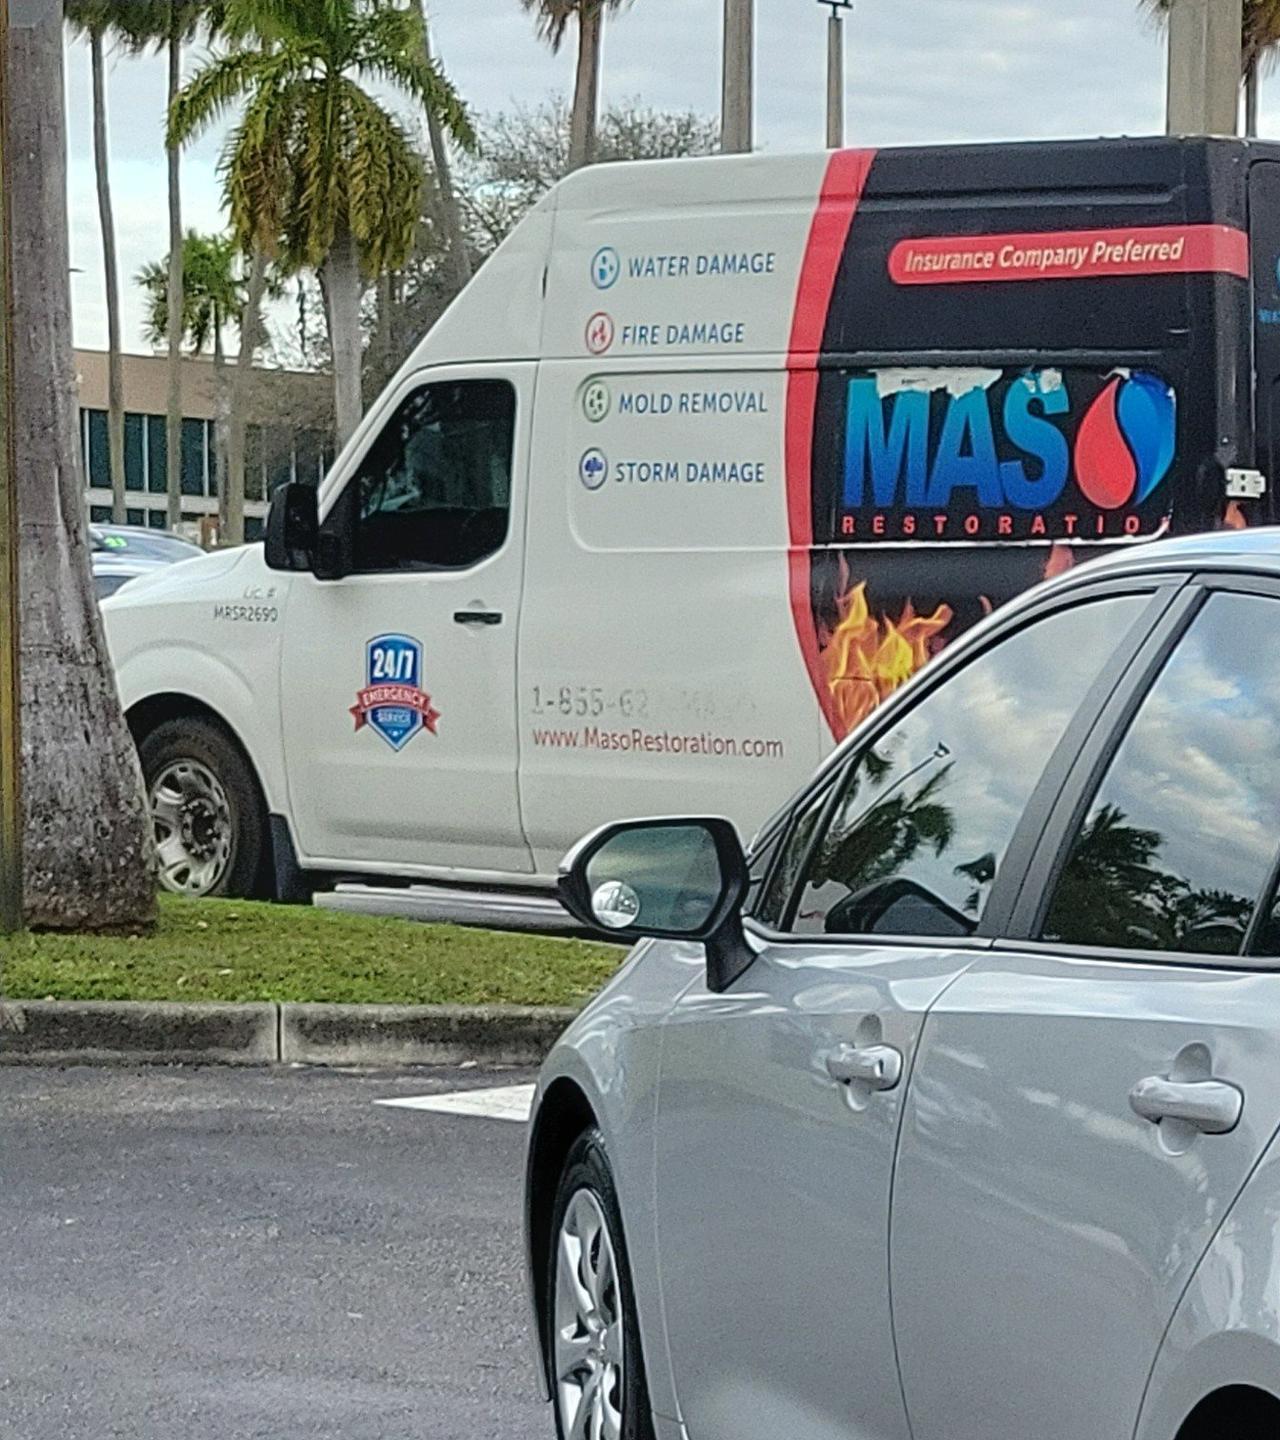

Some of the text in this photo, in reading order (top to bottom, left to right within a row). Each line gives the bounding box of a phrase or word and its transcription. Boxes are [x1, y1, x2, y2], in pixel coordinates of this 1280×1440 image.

[629, 252, 776, 277] WATER DAMAGE
[905, 237, 1184, 272] Insurance Company Preferred
[622, 323, 745, 345] FIRE DAMAGE
[618, 392, 768, 414] MOLD REMOVAL
[615, 462, 765, 483] STORM DAMAGE
[373, 648, 414, 679] 24/7
[362, 686, 427, 709] EMERGENCY
